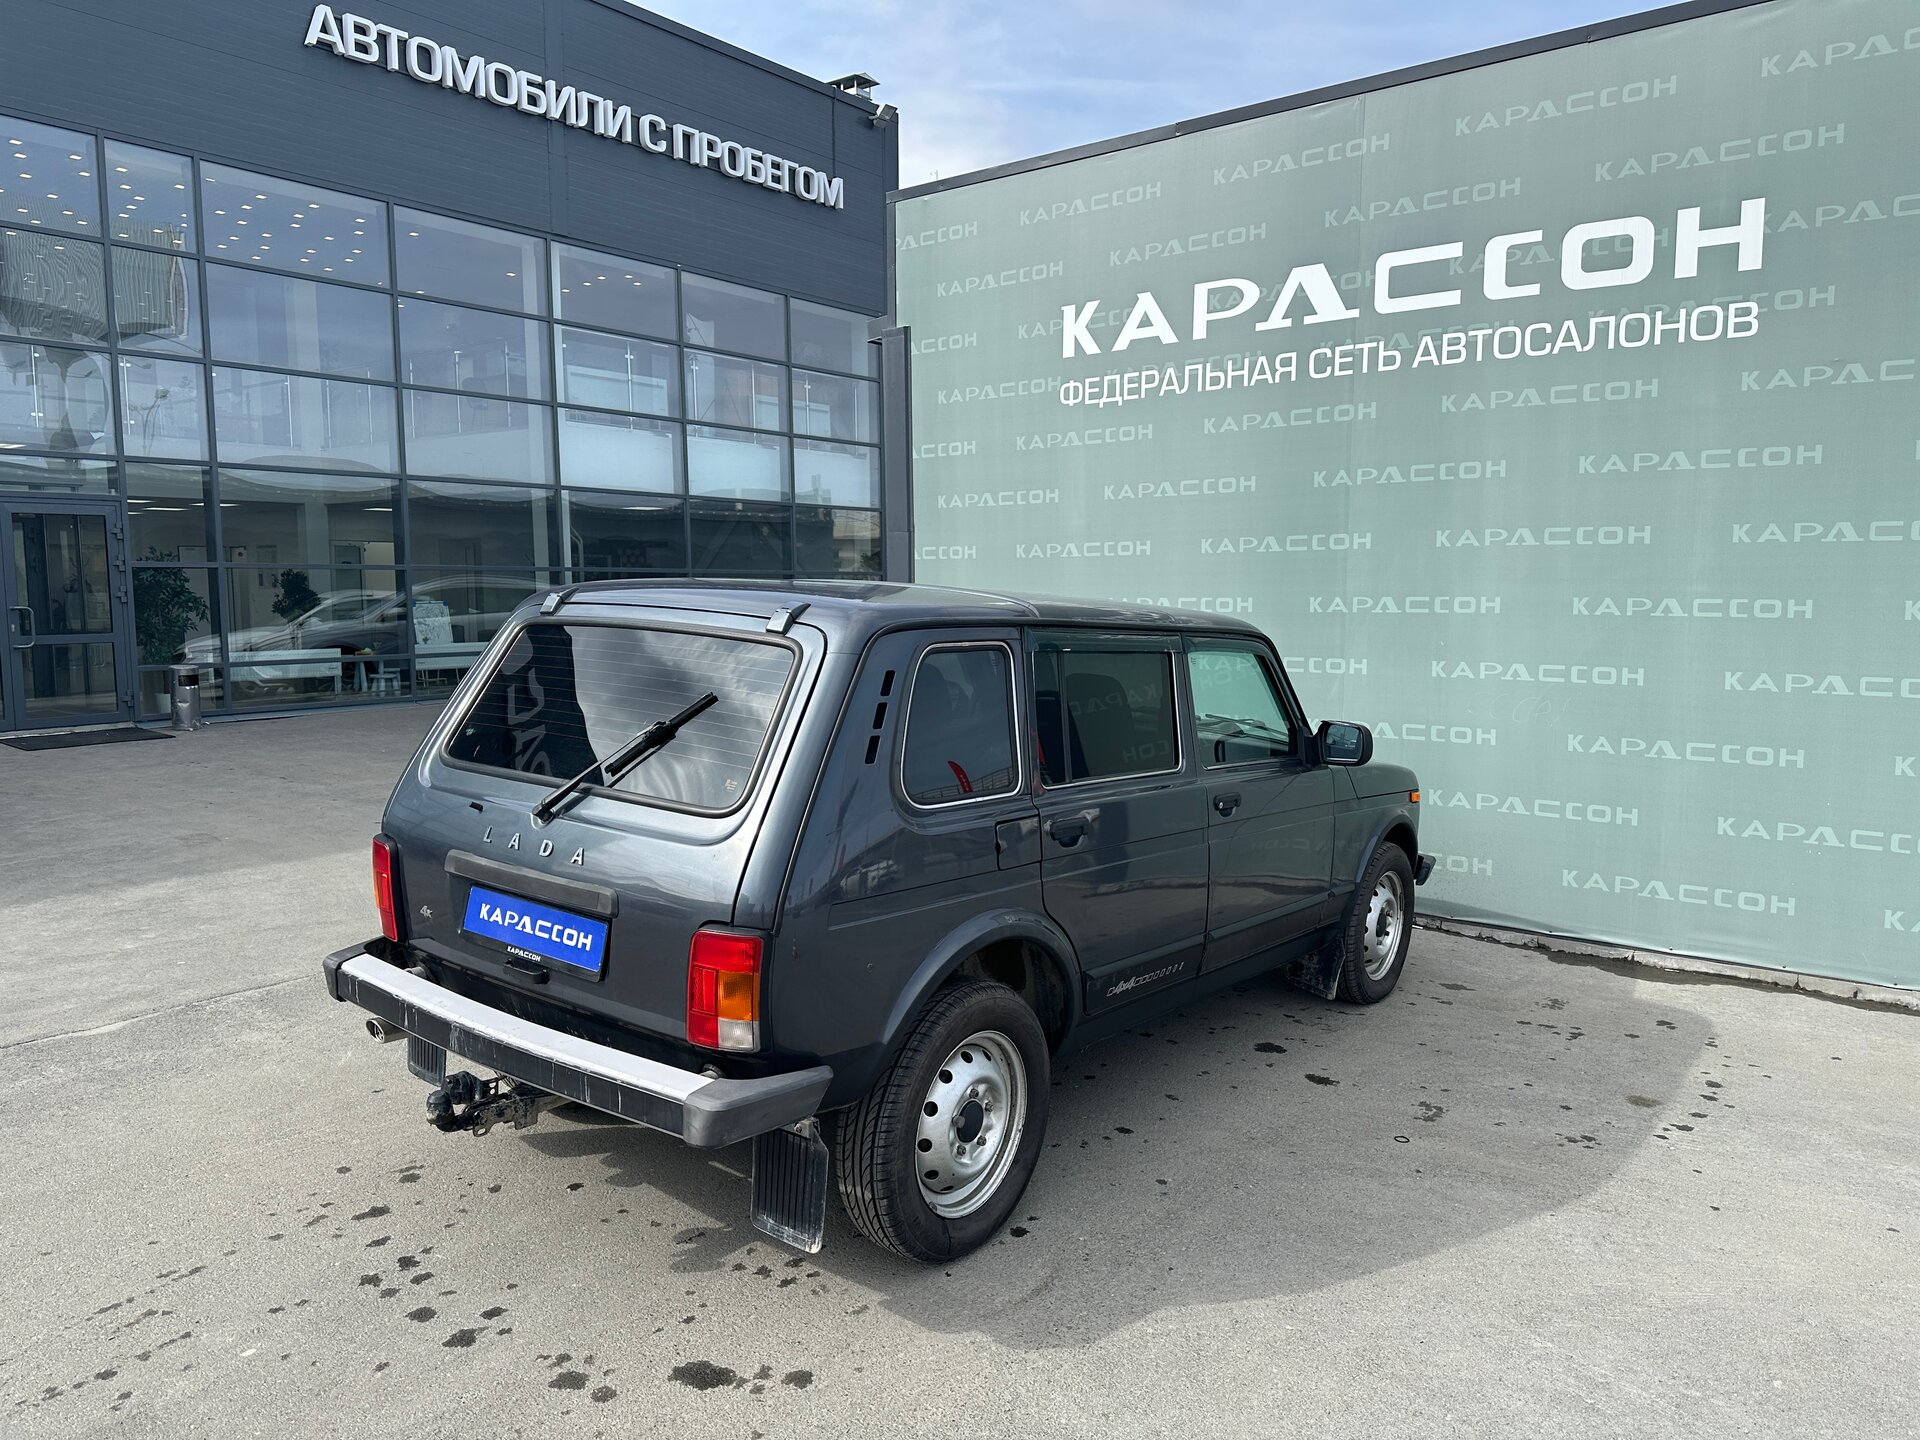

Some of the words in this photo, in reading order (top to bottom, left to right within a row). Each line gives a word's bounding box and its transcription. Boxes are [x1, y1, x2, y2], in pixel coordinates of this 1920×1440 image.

[304, 3, 632, 143] АВТОМОБИЛИ
[639, 113, 667, 154] С
[672, 123, 844, 210] ПРОБЕГОМ
[1456, 75, 1677, 136] КАРАССОН
[1214, 130, 1389, 185] КАРАССОН
[1595, 123, 1845, 182] КАРАССОН
[1020, 182, 1161, 226] КАРАССОН
[1325, 177, 1521, 228] КАРАССОН
[1110, 223, 1266, 266] КАРАССОН
[938, 261, 1062, 297] КАРАССОН
[1061, 197, 1766, 359] КАРАССОН
[1059, 351, 1297, 408] ФЕДЕРАЛЬНАЯ
[1308, 340, 1402, 379] СЕТЬ
[1412, 301, 1759, 370] АВТОСАЛОНОВ
[1442, 379, 1658, 412] КАРАССОН
[1204, 402, 1376, 434] КАРАССОН
[1017, 424, 1152, 450] КАРАССОН
[1314, 460, 1506, 487] КАРАССОН
[1579, 445, 1822, 473] КАРАССОН
[938, 489, 1058, 508] КАРАССОН
[1105, 476, 1256, 500] КАРАССОН
[1017, 541, 1150, 557] КАРАССОН
[1202, 533, 1371, 553] КАРАССОН
[1436, 526, 1651, 547] КАРАССОН
[1310, 597, 1500, 613] КАРАССОН
[1573, 597, 1813, 618] КАРАССОН
[1432, 661, 1644, 686] КАРАССОН
[1568, 734, 1804, 768] КАРАССОН
[1429, 789, 1638, 826] КАРАССОН
[483, 826, 585, 865] LADA
[1563, 869, 1795, 916] КАРАССОН
[479, 903, 593, 951] КАРАССОН
[507, 946, 541, 962] КАРАССОН
